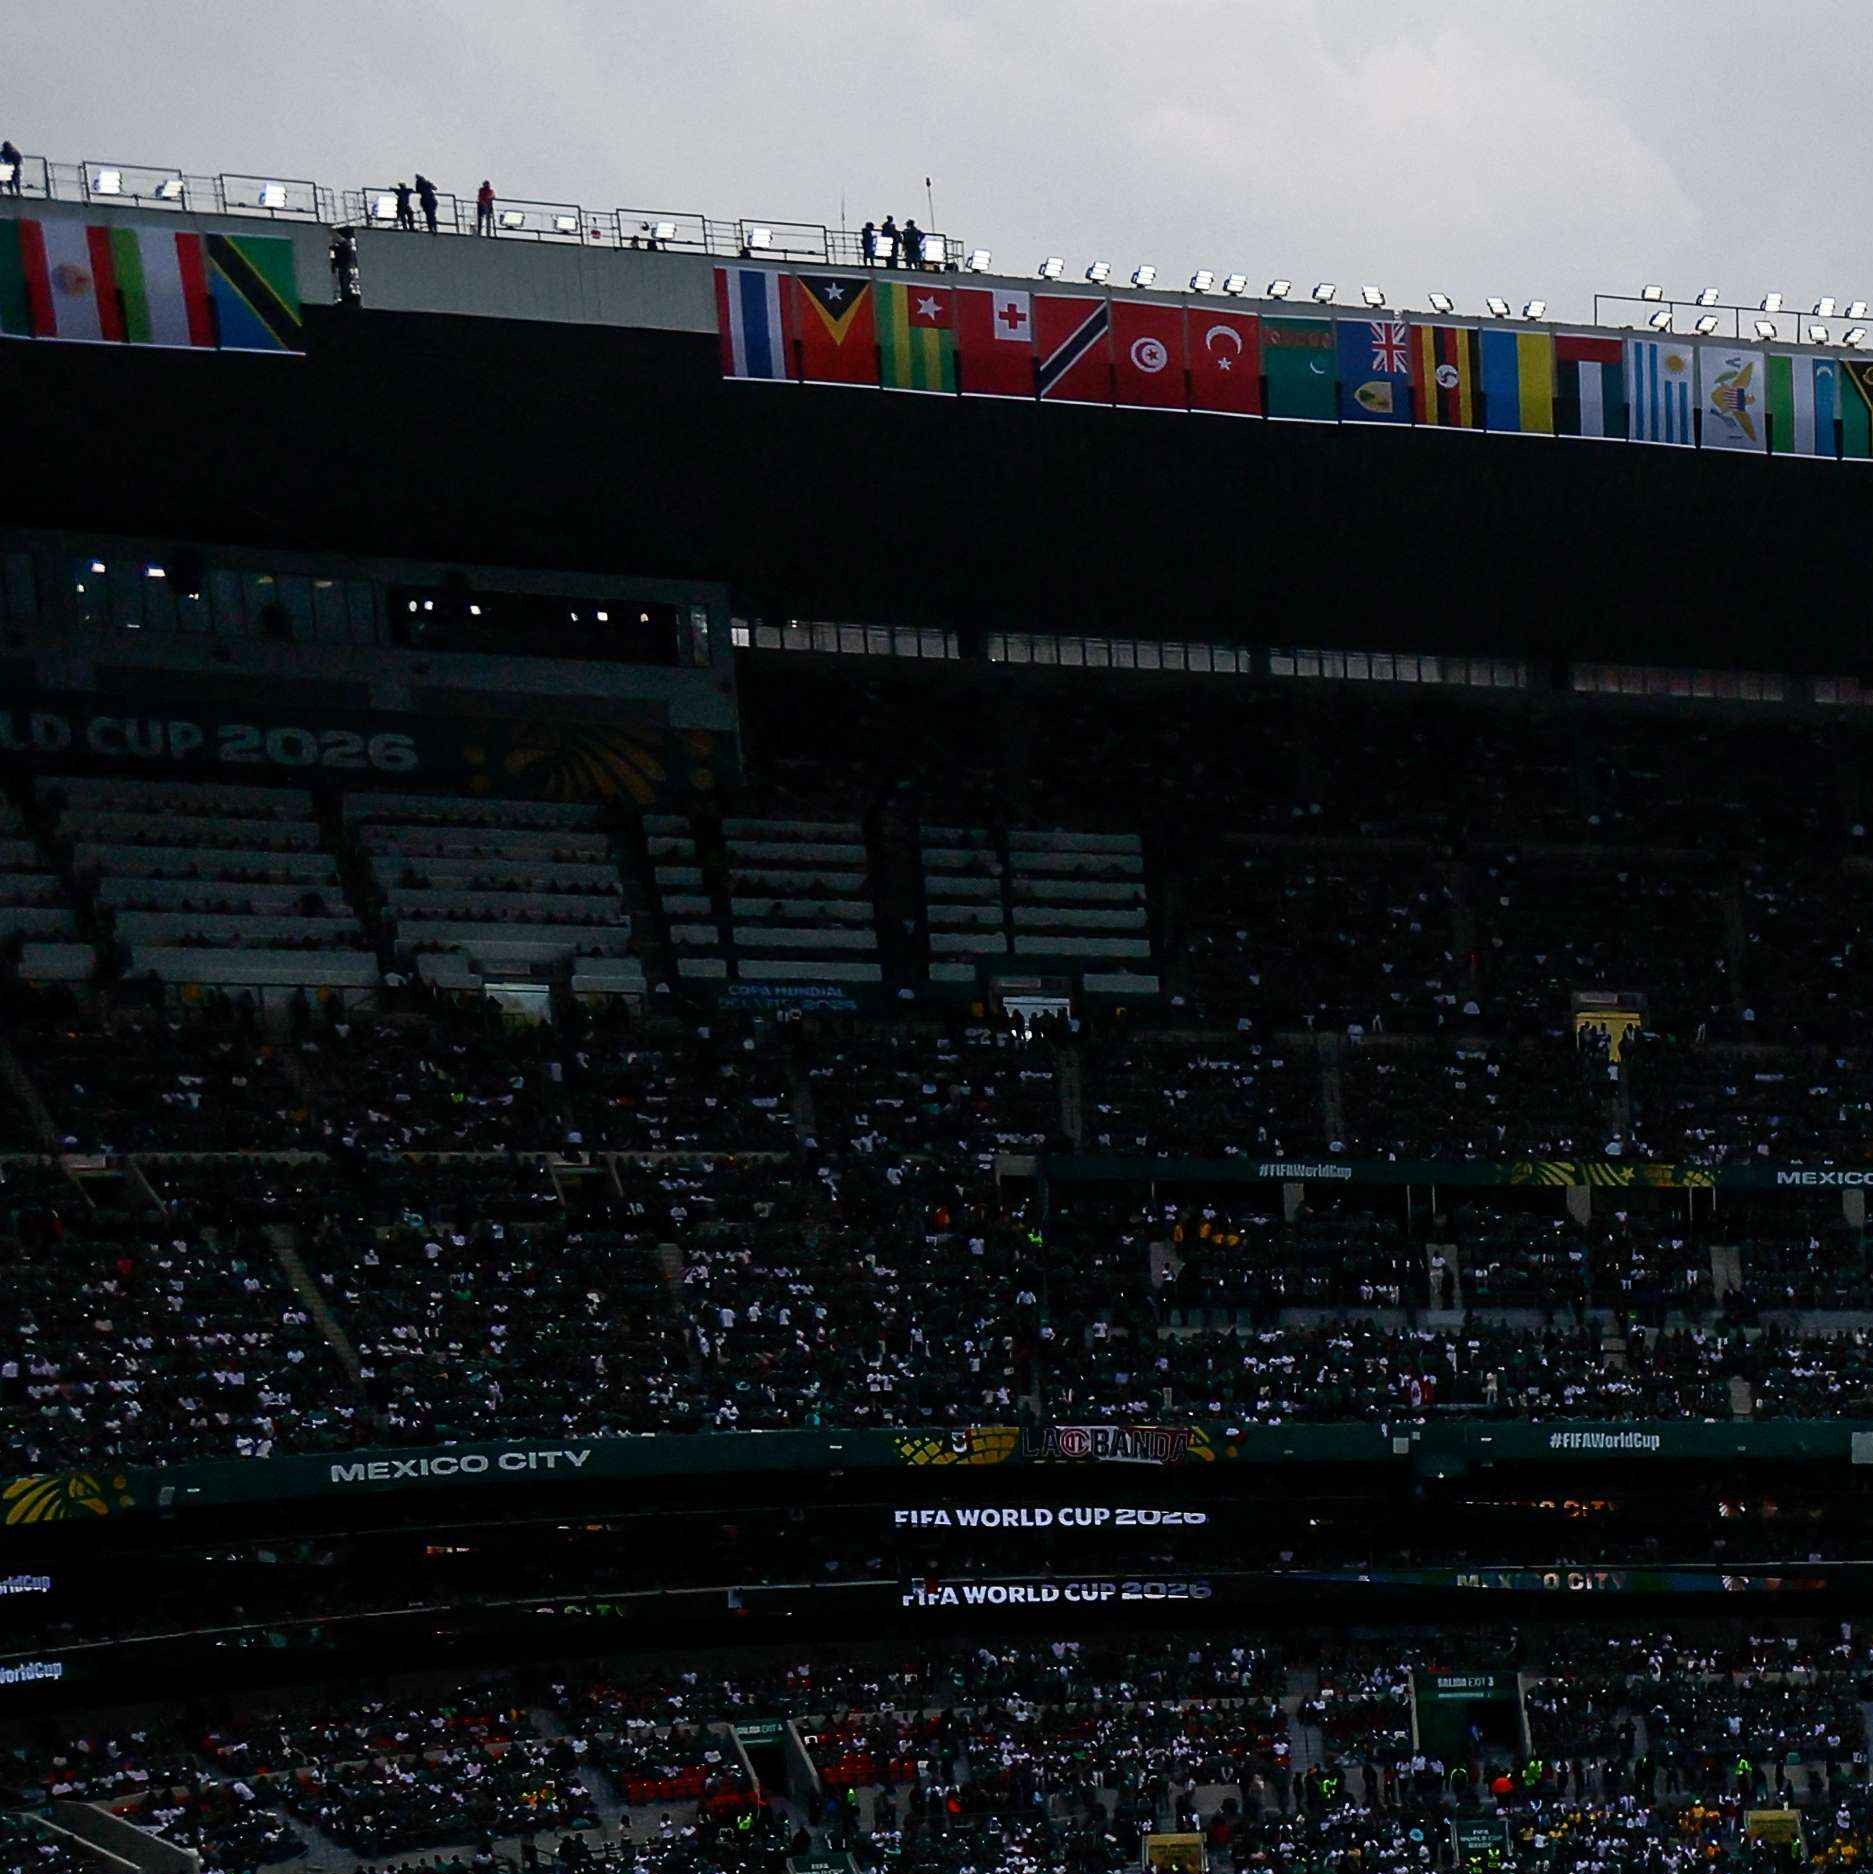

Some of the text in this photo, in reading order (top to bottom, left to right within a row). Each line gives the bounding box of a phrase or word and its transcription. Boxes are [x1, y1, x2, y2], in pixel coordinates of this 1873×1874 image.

[1550, 1432, 1660, 1451] #FIFAWorldCup
[331, 1449, 592, 1483] MEXICO CITY
[895, 1508, 1207, 1528] FIFA WORLD CUP 2026
[963, 1587, 1060, 1605] WORLD
[1064, 1585, 1117, 1602] CUP
[1120, 1582, 1213, 1601] 2026
